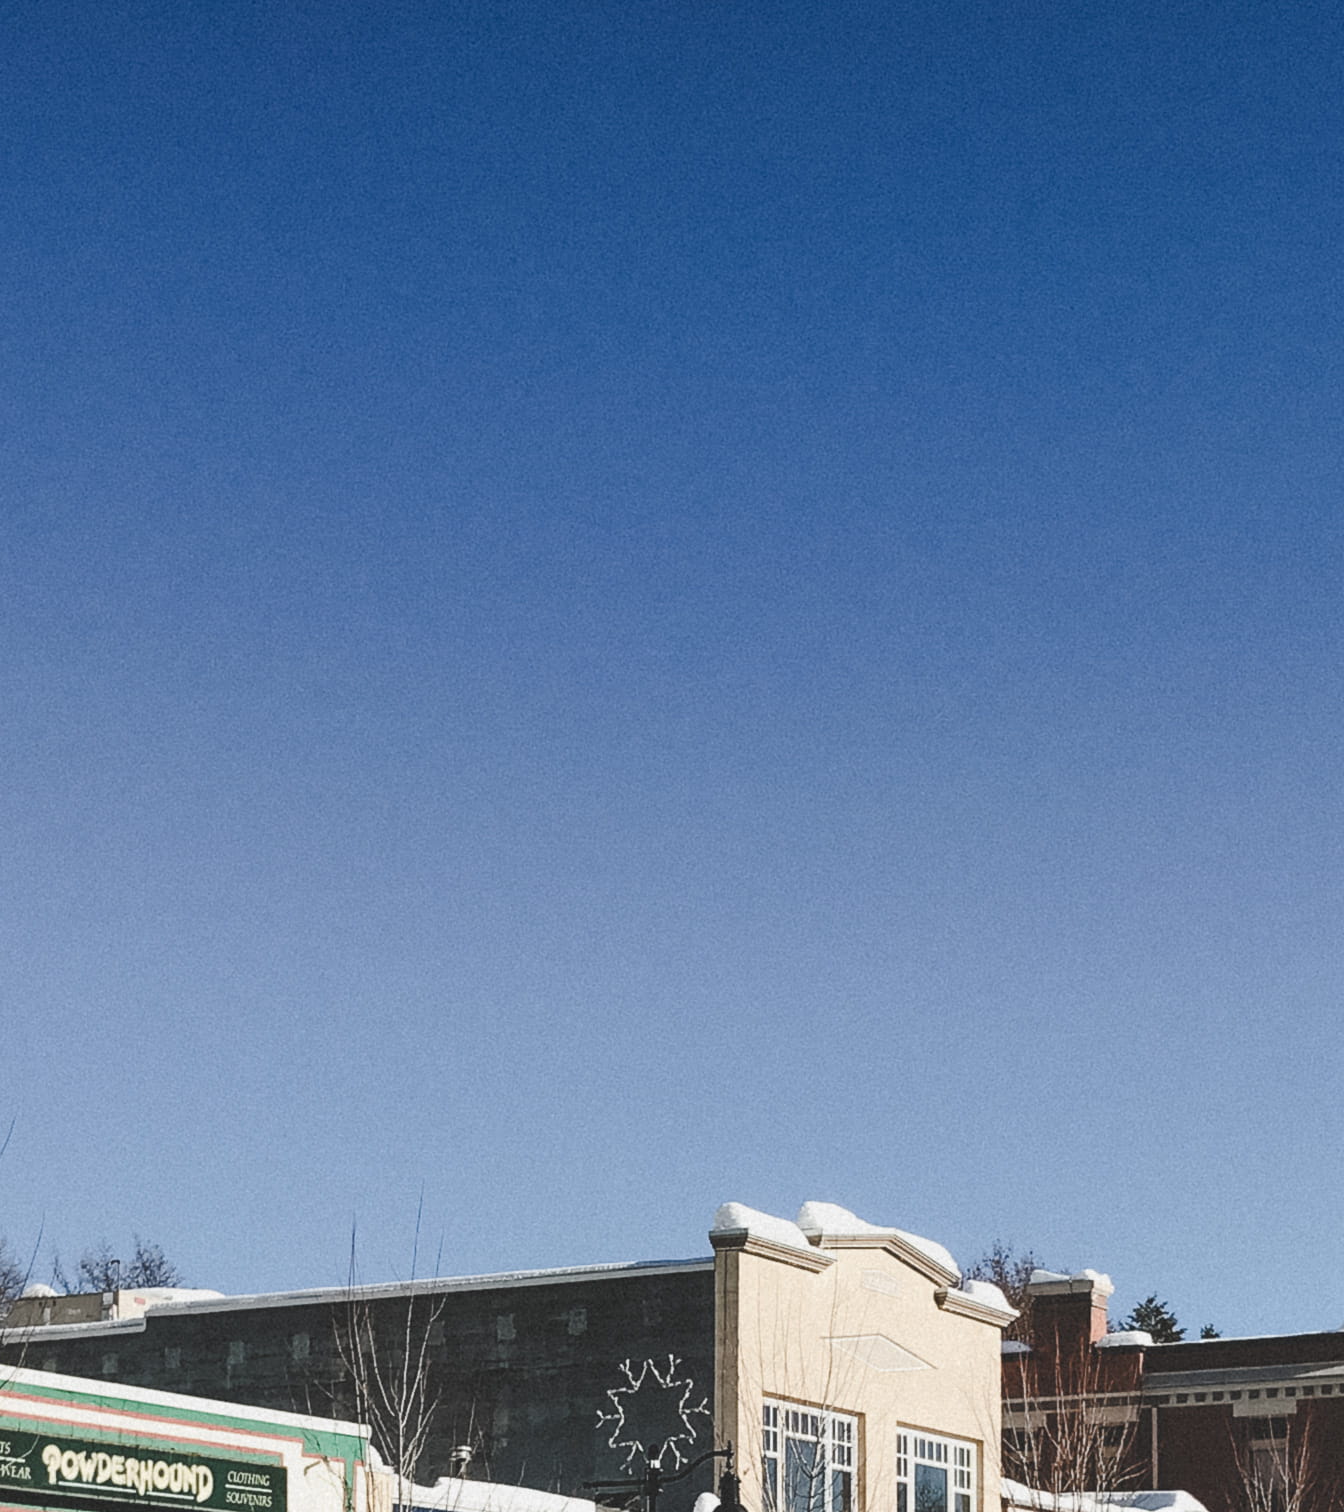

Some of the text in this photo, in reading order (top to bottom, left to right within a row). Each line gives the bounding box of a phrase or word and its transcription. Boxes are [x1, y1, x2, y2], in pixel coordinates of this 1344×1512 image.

[42, 1444, 214, 1503] POWDERHOUND
[227, 1470, 271, 1487] CLOTHING
[225, 1491, 273, 1508] SOUVENIRS
